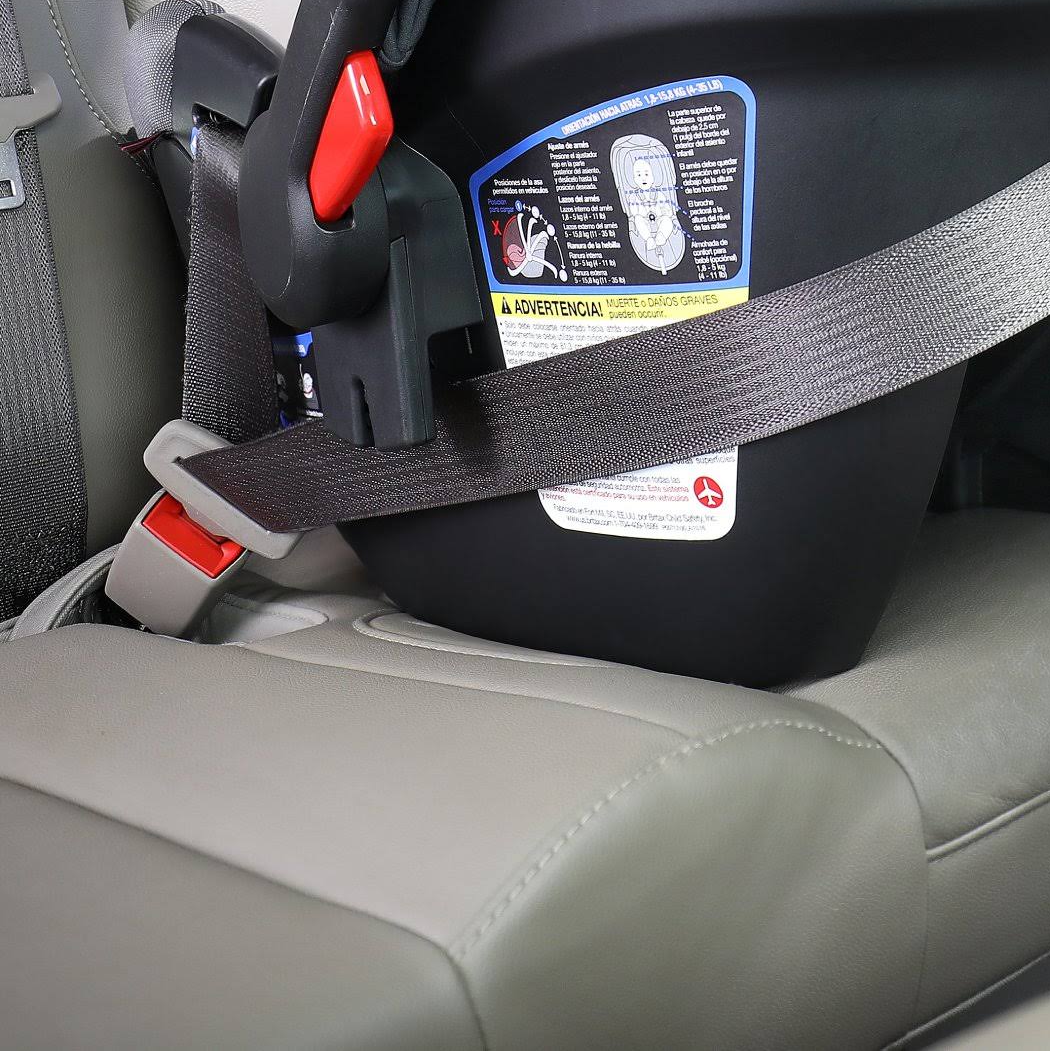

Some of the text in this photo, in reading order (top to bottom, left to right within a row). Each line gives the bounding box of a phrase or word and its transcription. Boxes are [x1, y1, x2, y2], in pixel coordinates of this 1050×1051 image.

[515, 299, 603, 317] ADVERTENCIA!
[606, 299, 639, 308] MUERTE
[648, 295, 678, 307] DAÑOS
[680, 294, 718, 306] GRAVES
[609, 310, 667, 319] pueden ocurrir.
